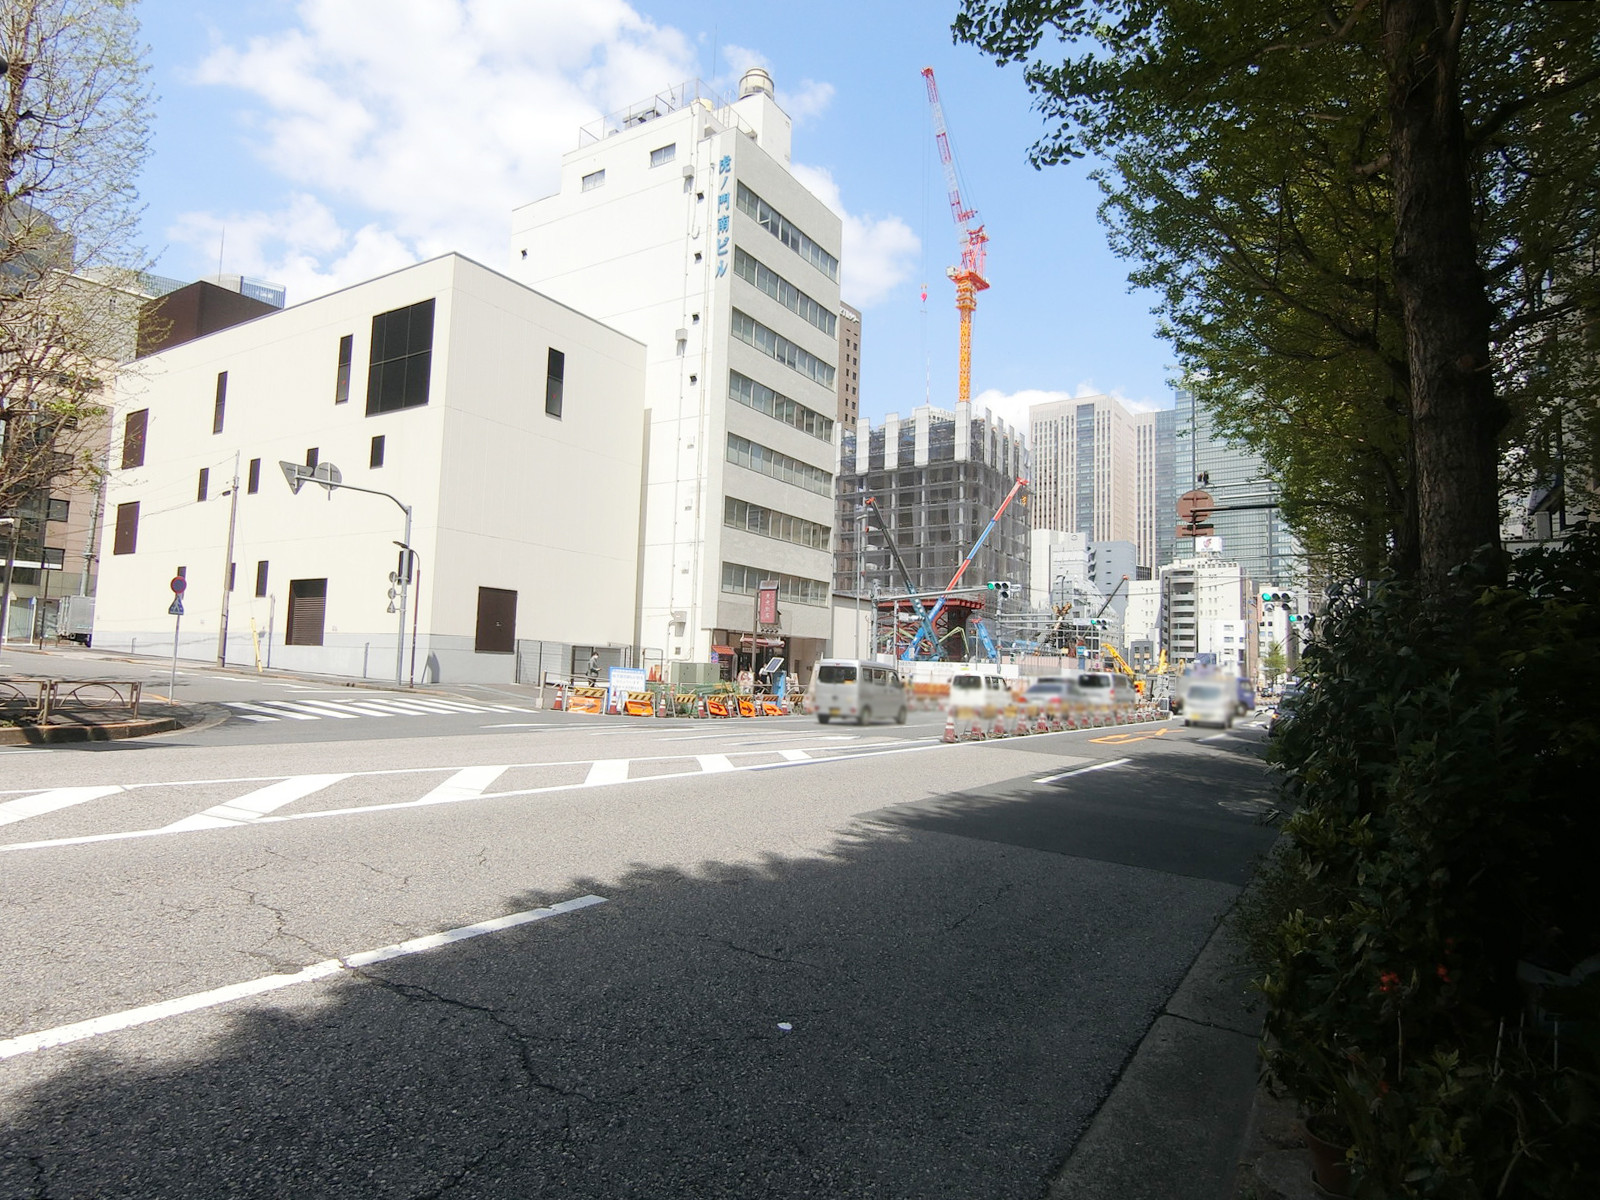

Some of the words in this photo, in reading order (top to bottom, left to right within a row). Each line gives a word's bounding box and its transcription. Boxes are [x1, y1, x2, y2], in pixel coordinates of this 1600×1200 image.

[715, 155, 731, 279] 虎ノ門南ビル
